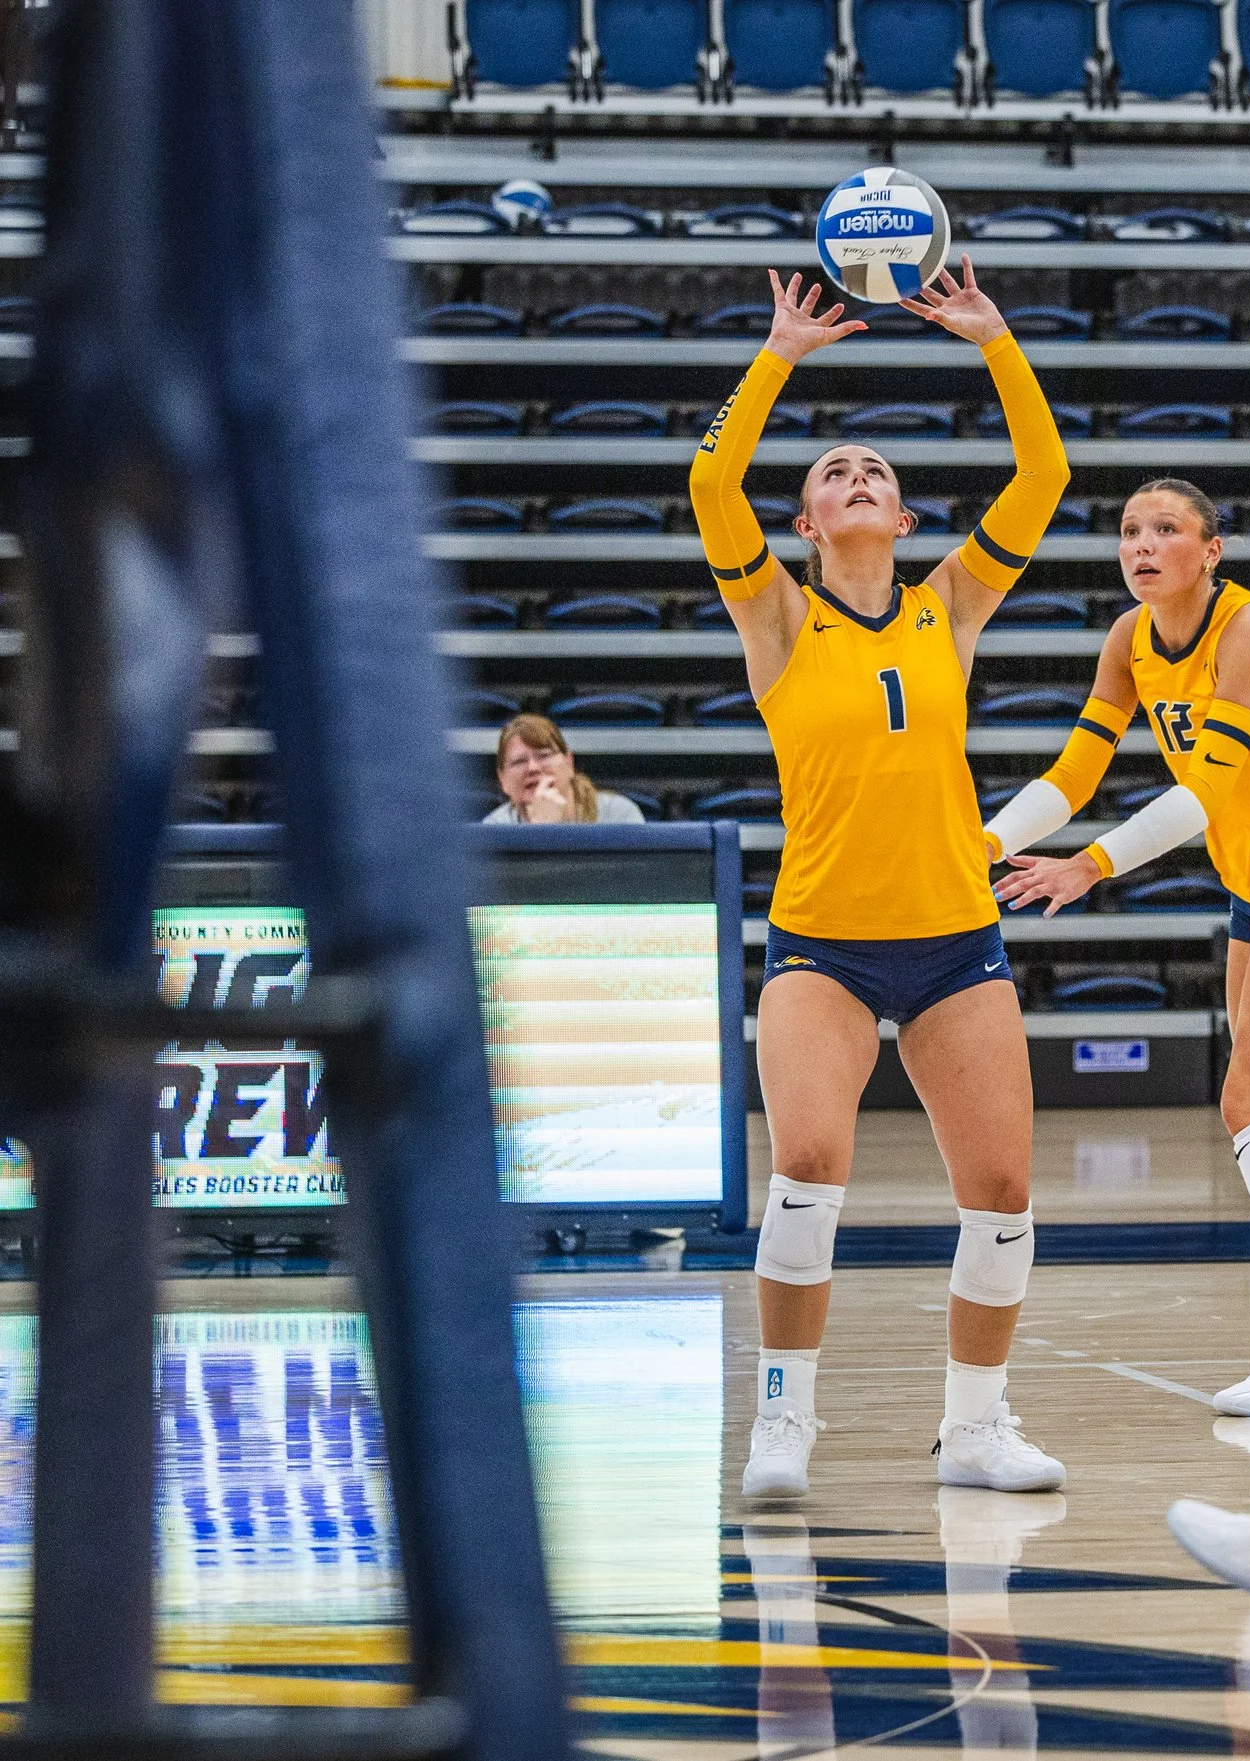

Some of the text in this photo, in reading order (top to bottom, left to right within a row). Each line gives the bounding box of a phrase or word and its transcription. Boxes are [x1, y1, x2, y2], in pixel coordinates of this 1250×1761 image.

[839, 214, 914, 234] molten
[842, 243, 913, 260] Super Touch
[699, 374, 748, 454] EAGL
[877, 666, 907, 734] 1
[1152, 700, 1198, 754] 12
[245, 926, 306, 940] COMM
[204, 1176, 299, 1194] BOOSTER
